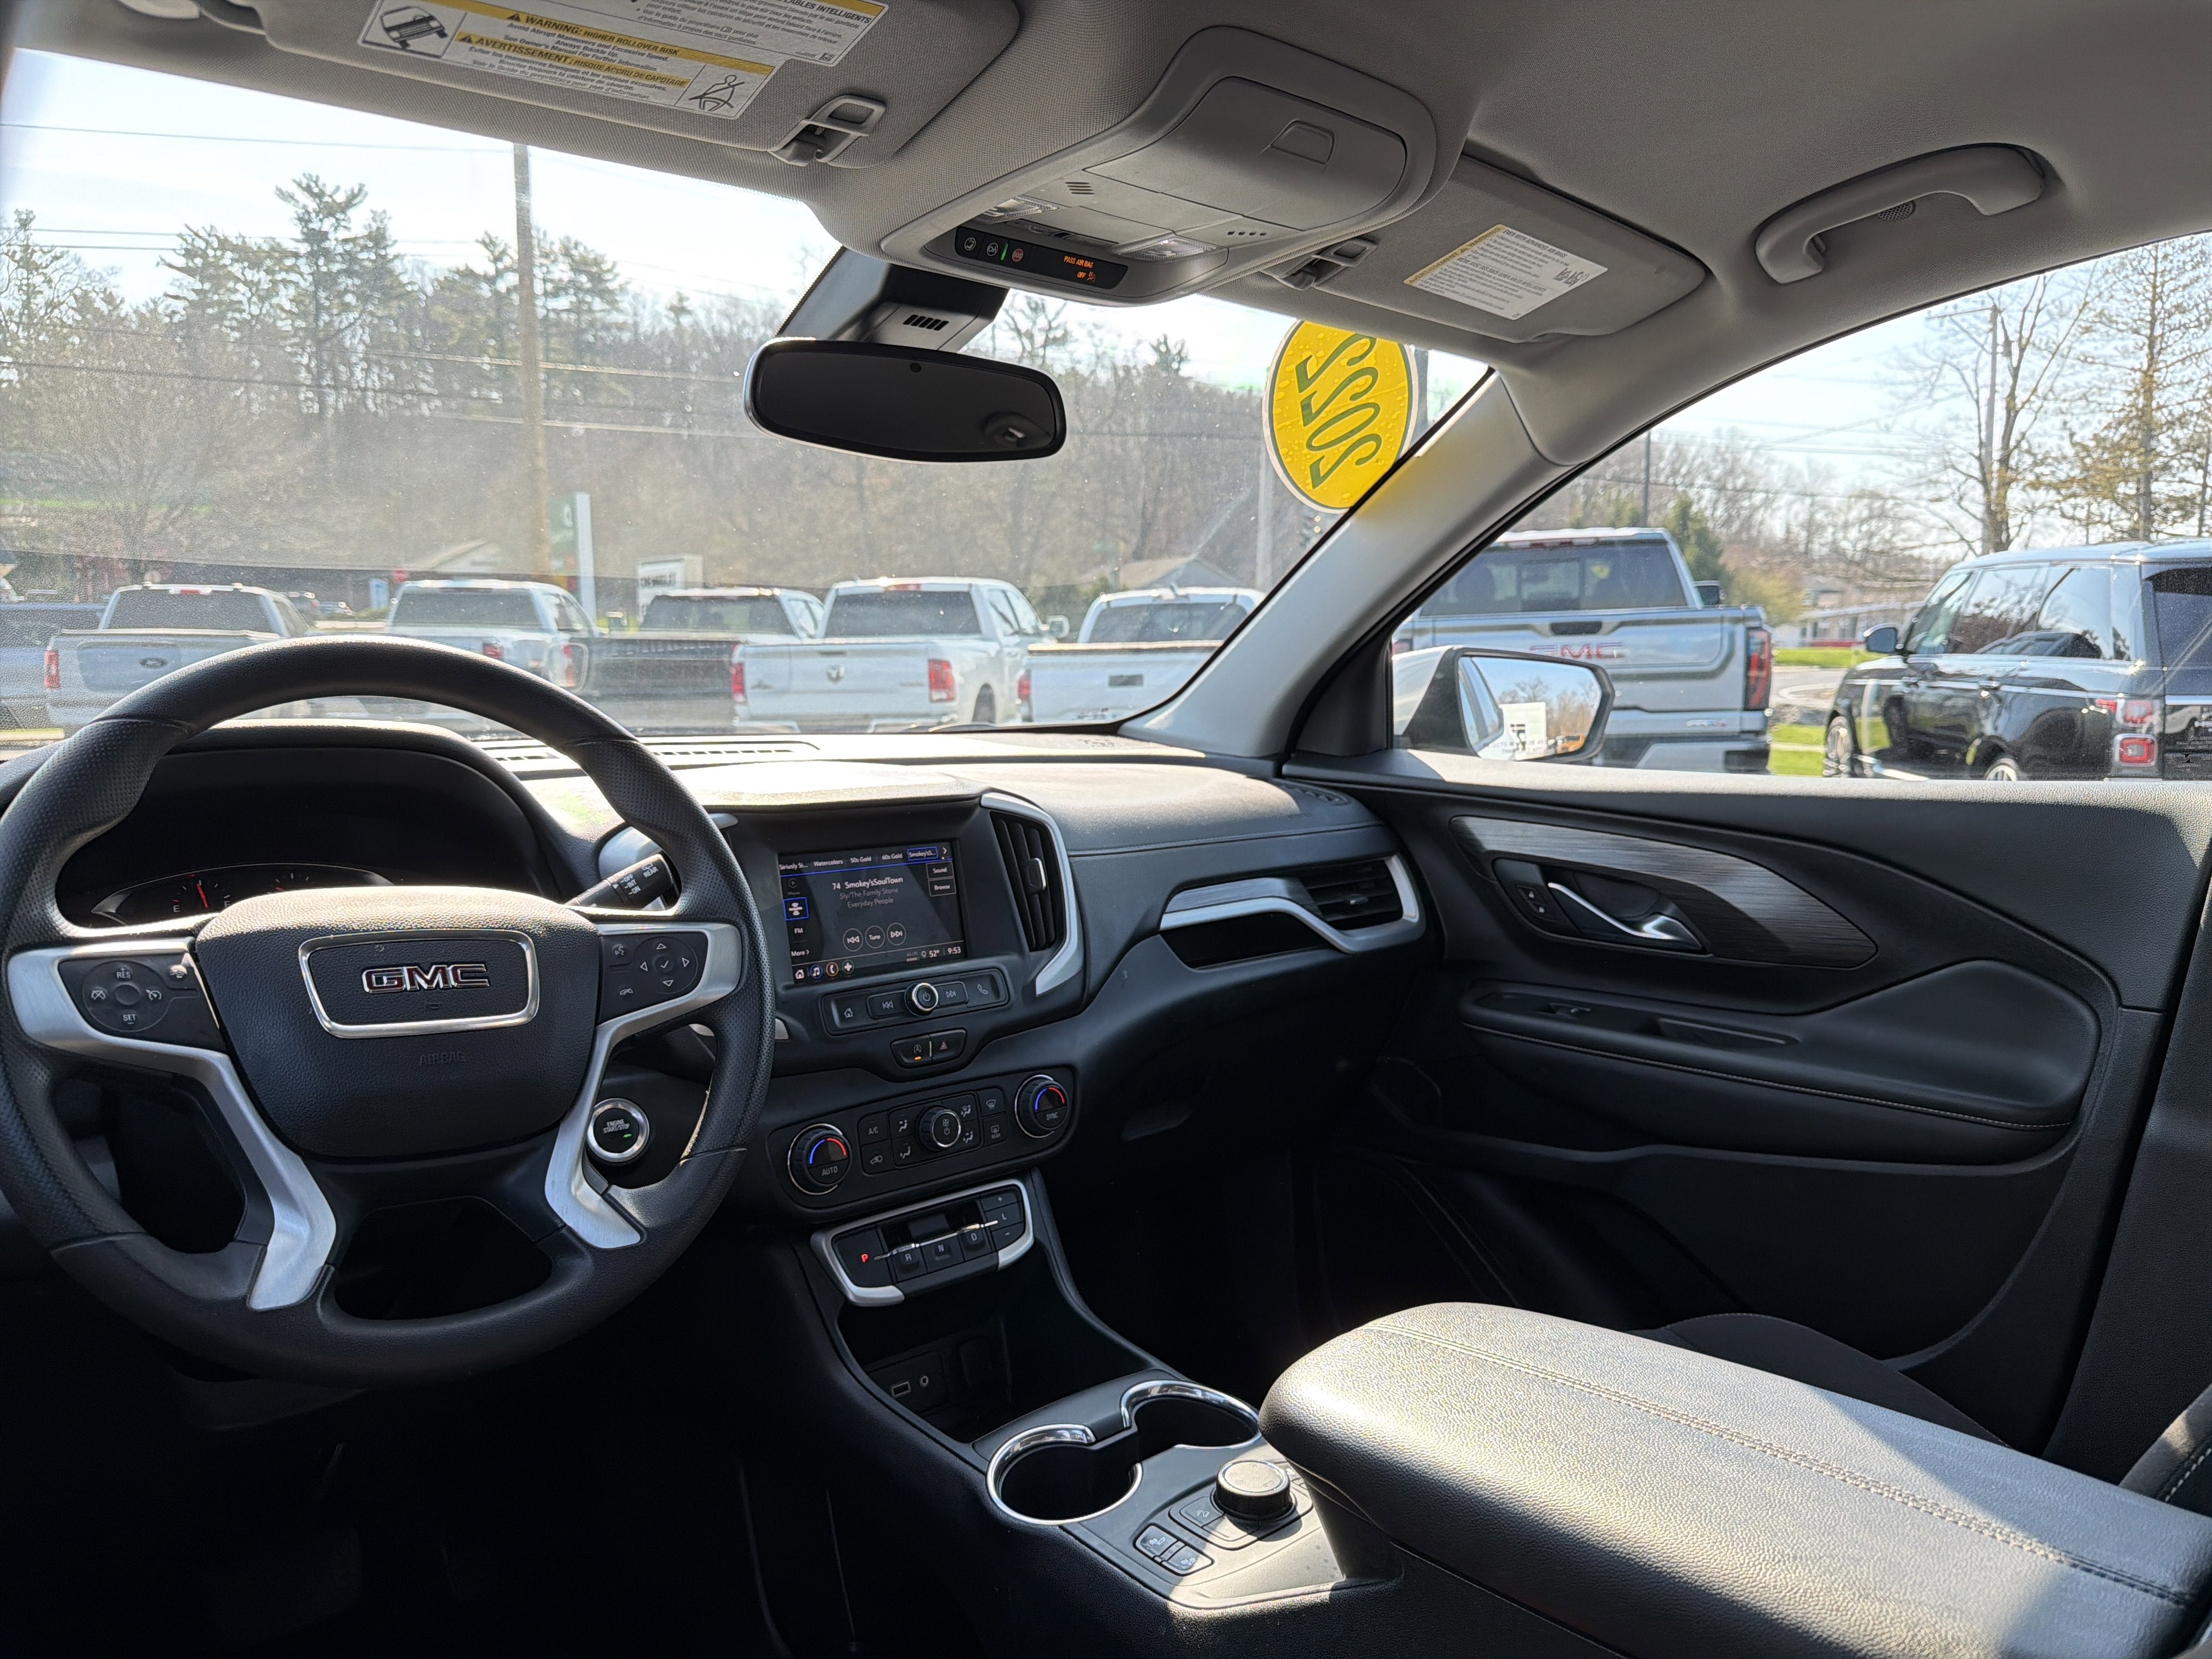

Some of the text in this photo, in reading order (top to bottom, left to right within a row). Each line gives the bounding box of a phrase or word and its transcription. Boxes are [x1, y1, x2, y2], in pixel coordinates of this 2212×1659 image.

[817, 5, 872, 24] INTELLIGENTS
[526, 15, 680, 55] WARNING: HIGHER ROLLOVER RISK
[508, 22, 529, 31] Avoid
[531, 28, 556, 38] Abrupt
[557, 33, 596, 46] Maneuvers
[612, 46, 646, 57] Excessive
[646, 53, 669, 63] Speed.
[555, 40, 580, 50] Always
[583, 46, 606, 54] Buckle
[520, 38, 550, 49] Owner's
[551, 45, 577, 55] Manual
[591, 54, 616, 63] Further
[618, 59, 658, 72] Information.
[499, 59, 527, 69] Boucler
[528, 65, 557, 76] toujours
[567, 72, 595, 82] ceinture
[574, 59, 605, 71] RISQUE
[605, 65, 633, 76] ACCRU
[645, 73, 686, 87] CAPOTAGE
[548, 63, 581, 75] brusques
[602, 74, 629, 83] vitesses
[630, 79, 668, 92] excessives.
[529, 71, 571, 85] propriétaire
[605, 86, 651, 101] d'information.
[1063, 256, 1094, 269] PASS AIR BAG
[623, 873, 634, 882] OFF
[643, 866, 658, 878] REAR
[631, 885, 641, 894] ON
[844, 877, 904, 890] Smokey'sSoulTown
[839, 890, 862, 900] Sly/The
[863, 888, 882, 897] Family
[847, 898, 894, 908] Everyday People
[928, 949, 940, 958] 52°
[947, 946, 961, 955] 9:53
[362, 964, 491, 994] GMC
[419, 1051, 466, 1068] AIRBAG
[1046, 1111, 1058, 1121] SYNC
[603, 1123, 630, 1134] START/STOP
[606, 1119, 625, 1127] ENGINE
[868, 1126, 878, 1135] A/C
[822, 1165, 838, 1176] AUTO
[971, 1233, 978, 1242] D
[938, 1244, 945, 1252] N
[861, 1254, 869, 1263] P
[905, 1253, 912, 1261] R
